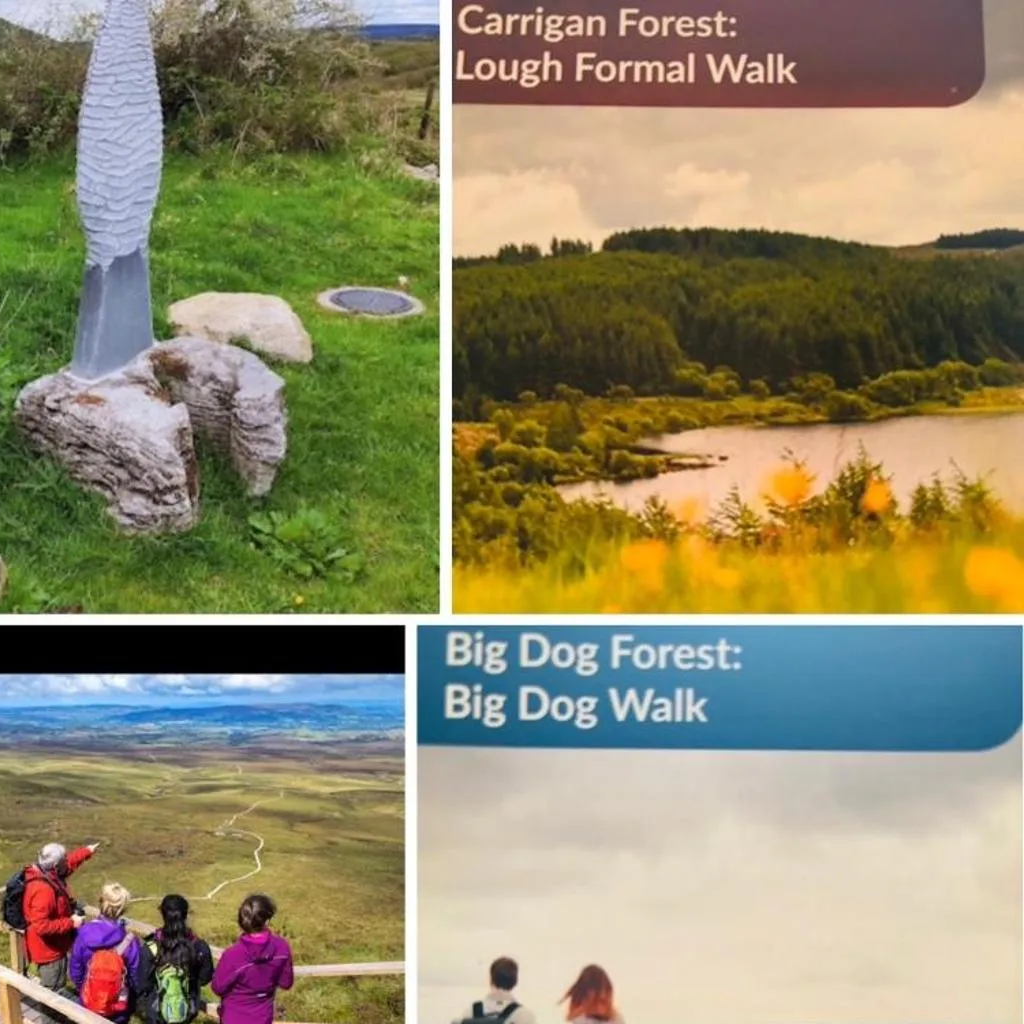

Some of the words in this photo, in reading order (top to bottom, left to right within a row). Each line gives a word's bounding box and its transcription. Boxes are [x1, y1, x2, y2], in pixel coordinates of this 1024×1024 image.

[458, 4, 606, 43] Carrigan
[619, 8, 737, 38] Forest:
[455, 49, 563, 88] Lough
[575, 52, 695, 83] Formal
[705, 53, 797, 84] Walk
[446, 631, 508, 675] Big
[519, 632, 599, 677] Dog
[611, 634, 742, 670] Forest:
[445, 683, 507, 728] Big
[519, 685, 599, 730] Dog
[608, 687, 708, 722] Walk
